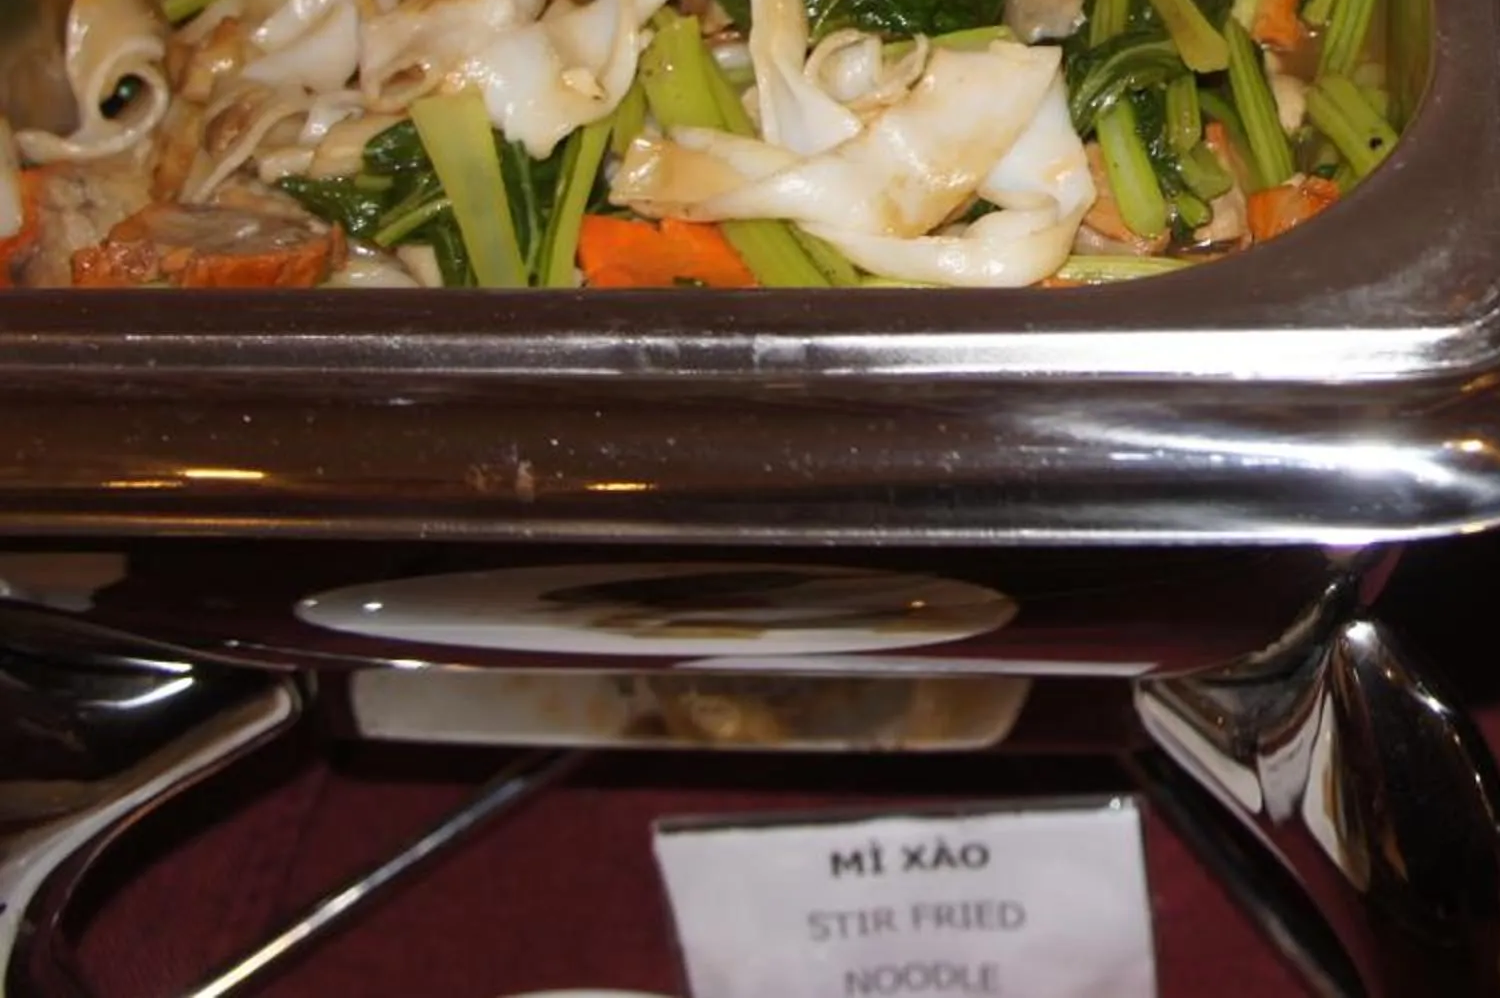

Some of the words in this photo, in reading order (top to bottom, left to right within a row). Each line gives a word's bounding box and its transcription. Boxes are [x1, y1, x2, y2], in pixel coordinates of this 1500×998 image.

[829, 839, 884, 880] MÌ
[901, 836, 991, 872] XÀO
[806, 906, 898, 942] STIR
[911, 899, 1026, 932] FRIED
[844, 959, 1001, 998] NOODLE
